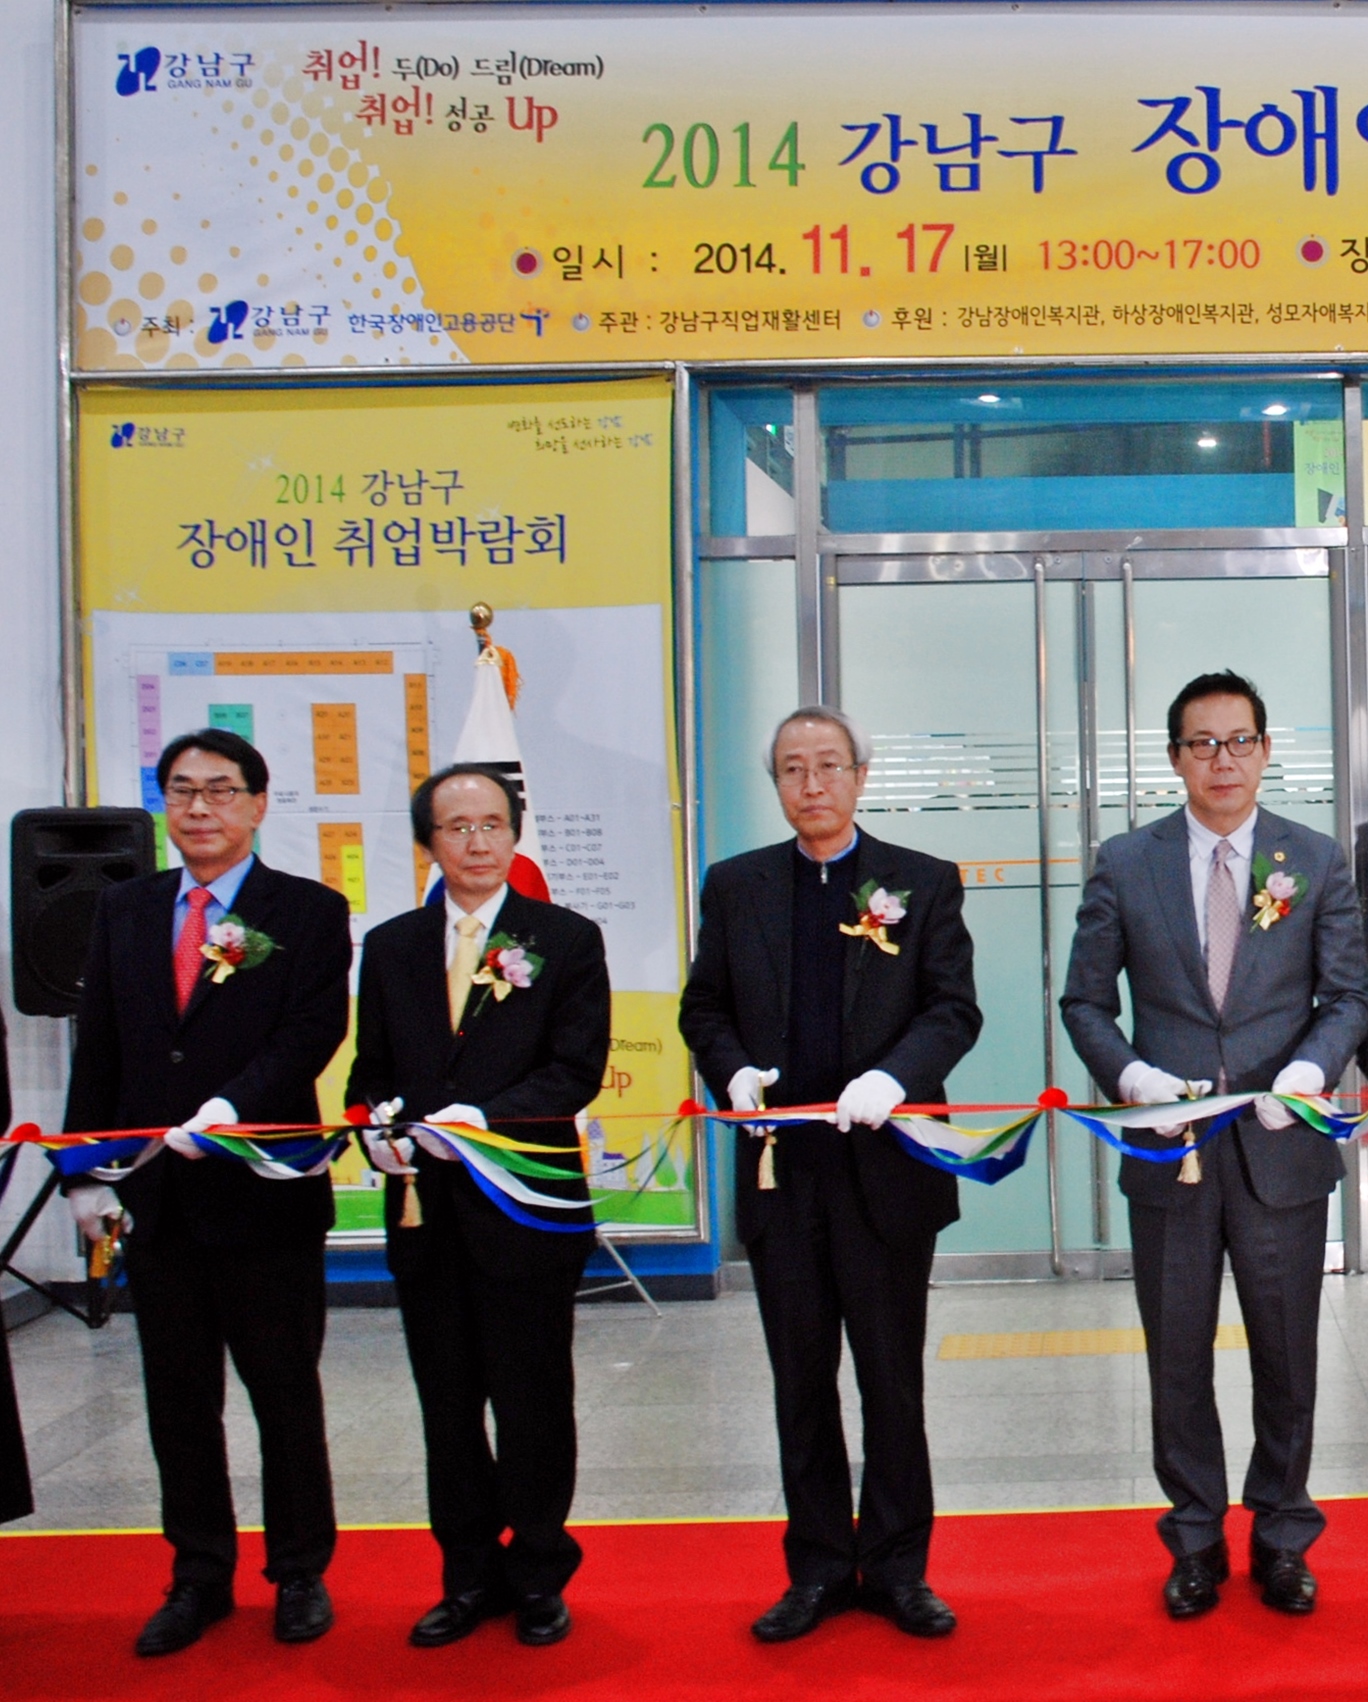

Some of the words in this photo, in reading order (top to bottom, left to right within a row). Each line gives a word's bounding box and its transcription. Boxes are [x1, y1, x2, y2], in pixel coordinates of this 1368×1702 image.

[163, 52, 254, 83] 강남구
[302, 40, 381, 90] 취업!
[392, 56, 459, 81] 두(Do)
[470, 52, 604, 85] 드림(Dream)
[167, 78, 201, 88] GANG
[204, 78, 233, 88] NAM
[236, 77, 254, 88] GU
[355, 86, 434, 135] 취업!
[444, 97, 495, 133] 성공
[505, 97, 558, 142] Up
[642, 121, 806, 190] 2014
[838, 113, 1077, 194] 강남구
[553, 245, 625, 280] 일시
[693, 243, 787, 275] 2014.
[802, 224, 872, 277] 11.
[896, 223, 955, 274] 17
[1037, 239, 1261, 271] 13:00~17:00
[141, 316, 181, 337] 주최
[253, 304, 331, 328] 강남구
[348, 313, 516, 335] 한국장애인고용공단
[599, 312, 638, 333] 주관
[659, 309, 842, 332] 강남구직업재활센터
[891, 307, 933, 331] 후원
[957, 306, 1105, 329] 강남장애인복지관,
[1112, 304, 1258, 326] 하상장애인복지관,
[253, 328, 283, 336] GANG
[286, 328, 310, 336] NAM
[137, 426, 186, 442] 강남구
[276, 473, 346, 504] 2014
[361, 469, 464, 506] 강남구
[176, 518, 317, 569] 장애인
[333, 514, 569, 568] 취업박람회
